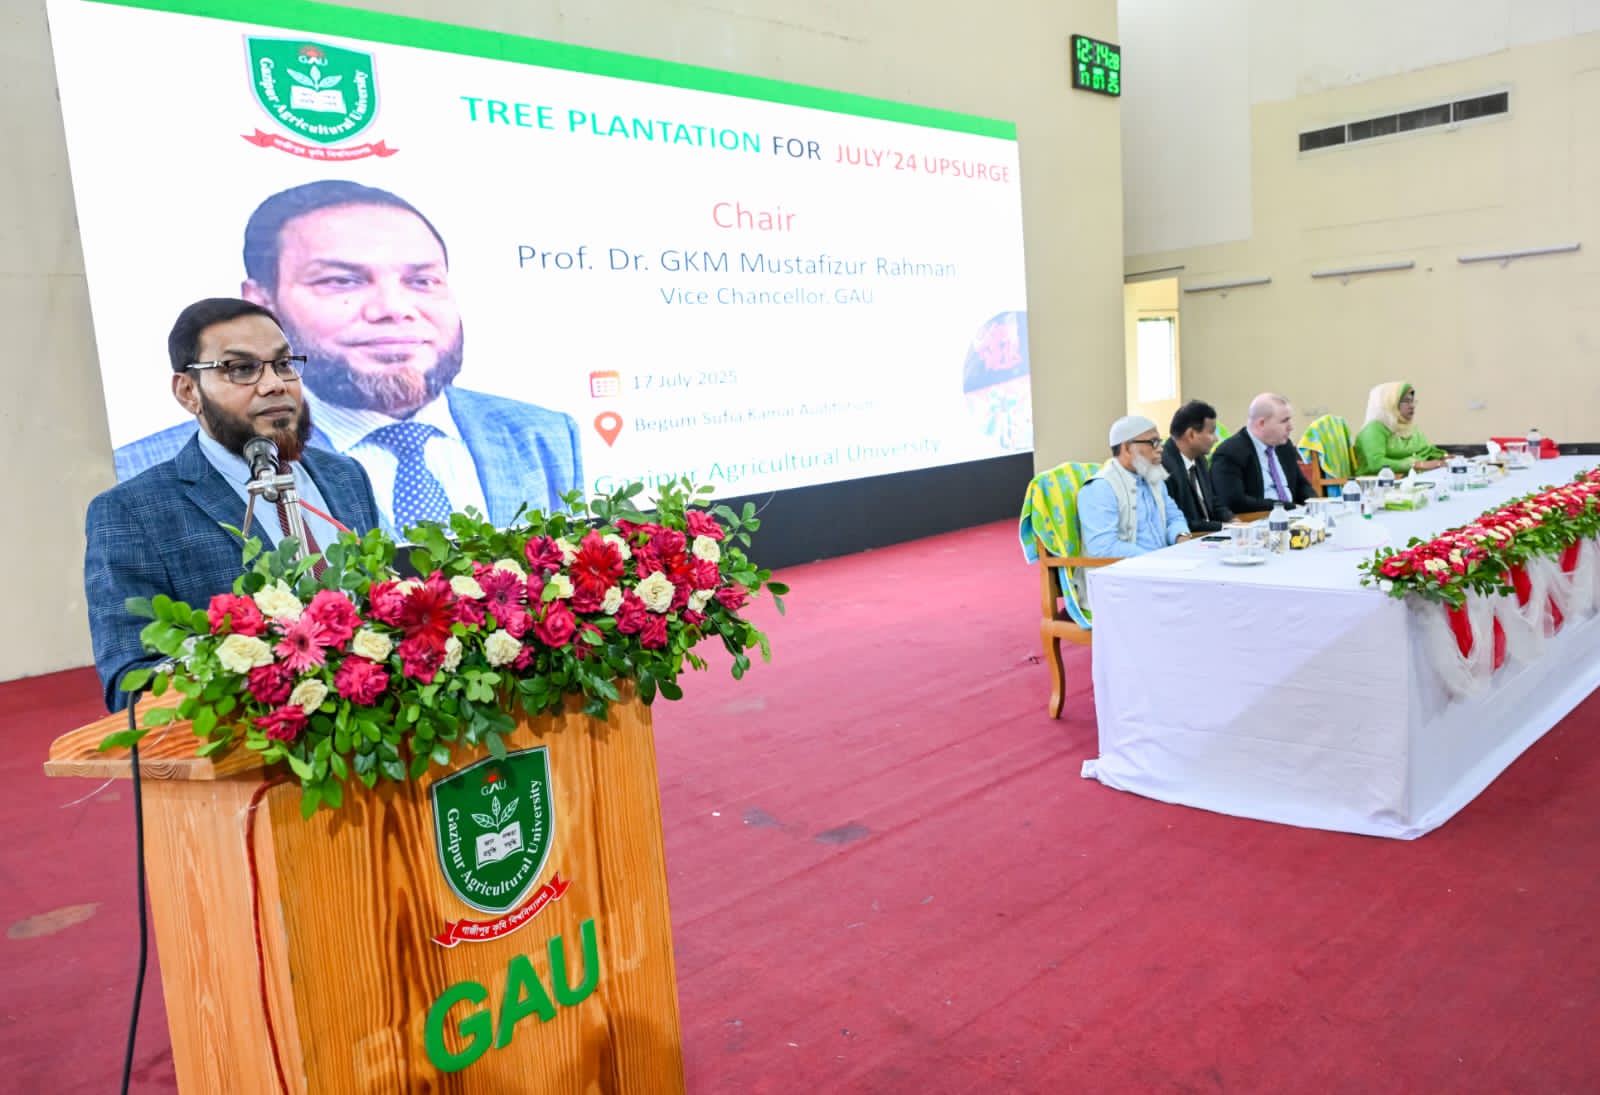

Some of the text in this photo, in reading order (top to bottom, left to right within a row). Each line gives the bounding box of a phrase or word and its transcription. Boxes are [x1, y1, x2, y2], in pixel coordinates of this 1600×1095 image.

[298, 55, 328, 66] GAU
[460, 96, 1010, 184] TREE PLANTATION FOR JULY'24 UPSURGE
[713, 202, 797, 232] Chair
[518, 245, 957, 278] Prof. Dr. GKM Mustafizur Rahman
[660, 287, 713, 304] Vice
[834, 287, 874, 304] GAU
[633, 369, 738, 390] 17 July 2025
[634, 414, 697, 433] Begum
[708, 446, 839, 484] Agricultural
[847, 436, 942, 463] University
[480, 779, 507, 796] GAU
[447, 780, 543, 897] Gazipur Agricultural University
[424, 918, 600, 1073] GAU
